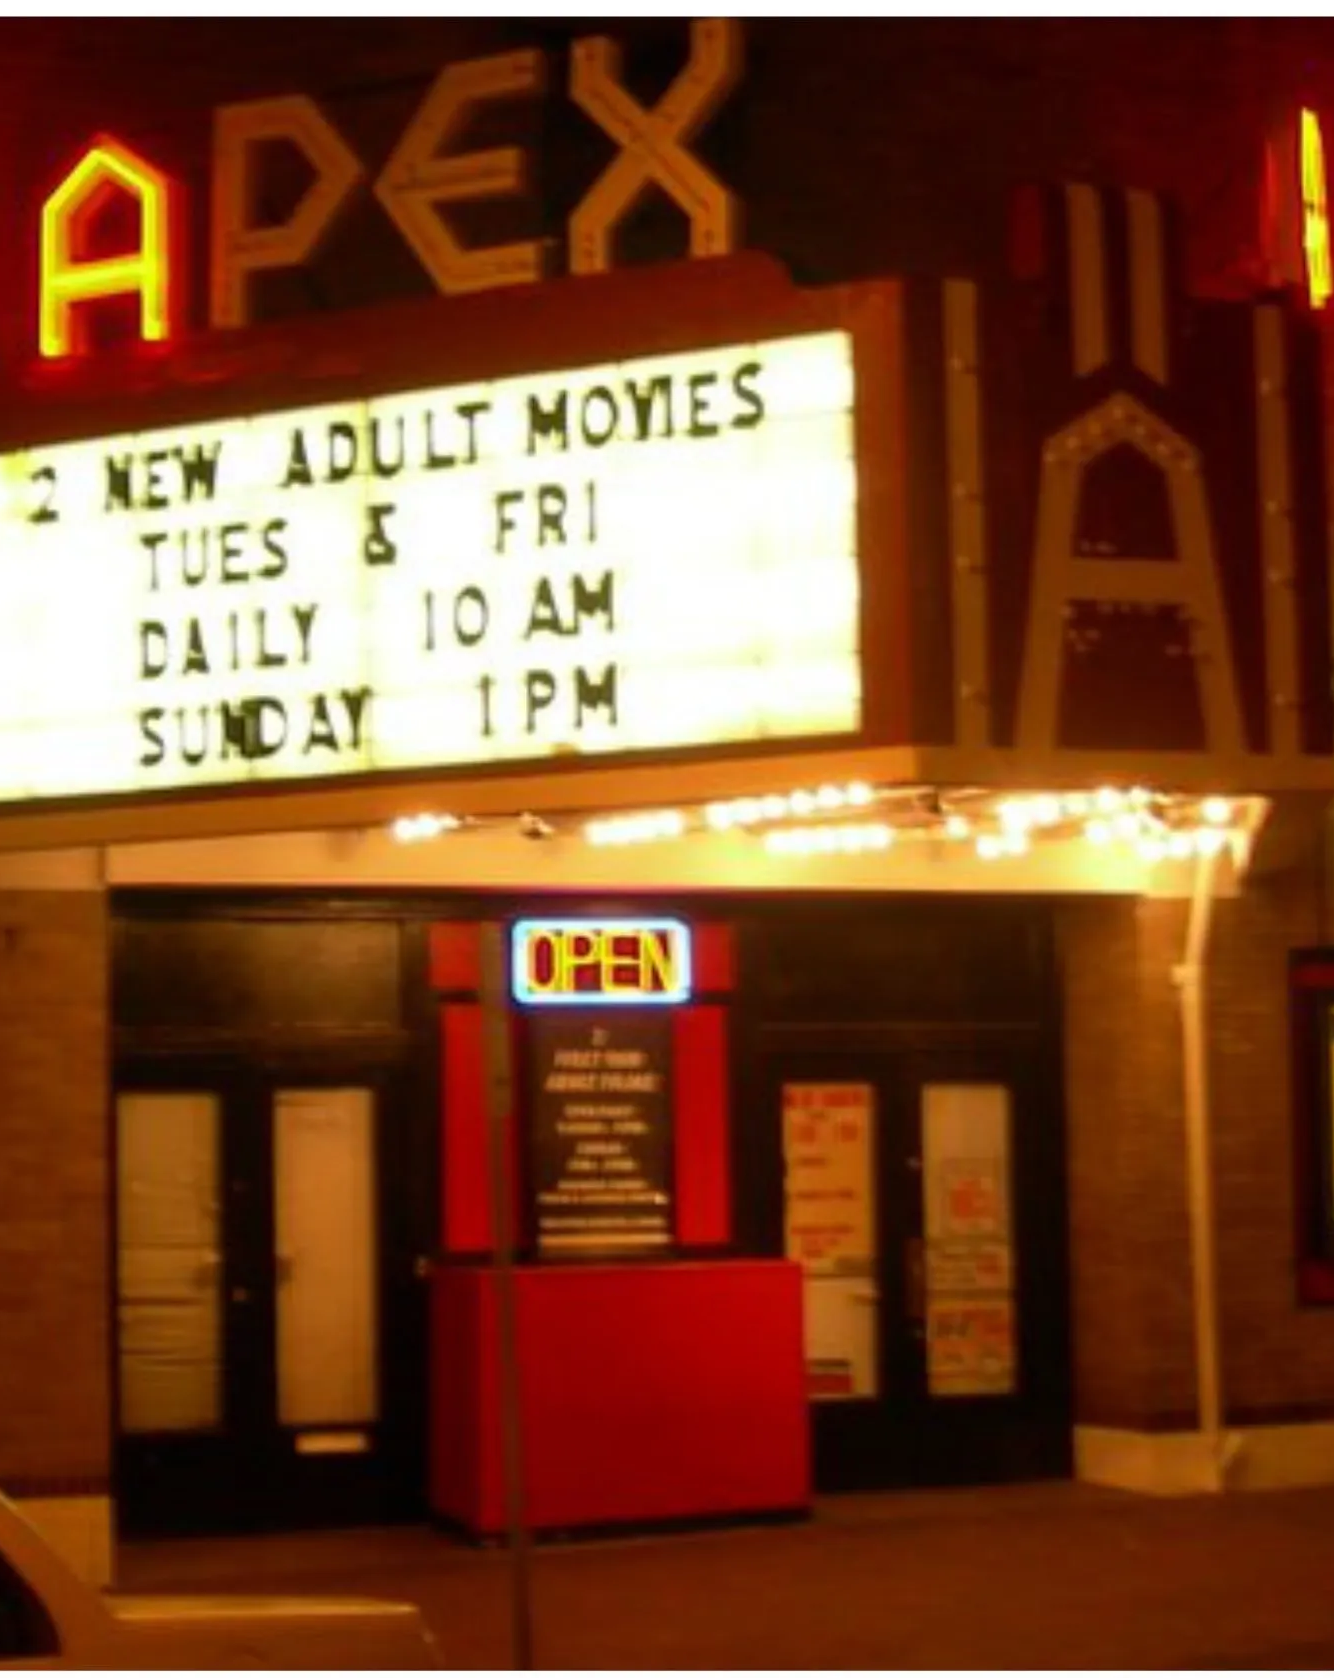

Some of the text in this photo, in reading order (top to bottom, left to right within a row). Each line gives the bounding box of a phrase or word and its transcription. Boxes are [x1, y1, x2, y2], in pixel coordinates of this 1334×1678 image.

[41, 17, 731, 354] APEX
[28, 361, 767, 524] 2 NEW ADULT MOVIES
[140, 482, 597, 591] TUES & FRI
[140, 571, 616, 680] DAILY 10 AM
[140, 664, 619, 769] SUNDAY 1 PM
[527, 931, 679, 993] OPEN
